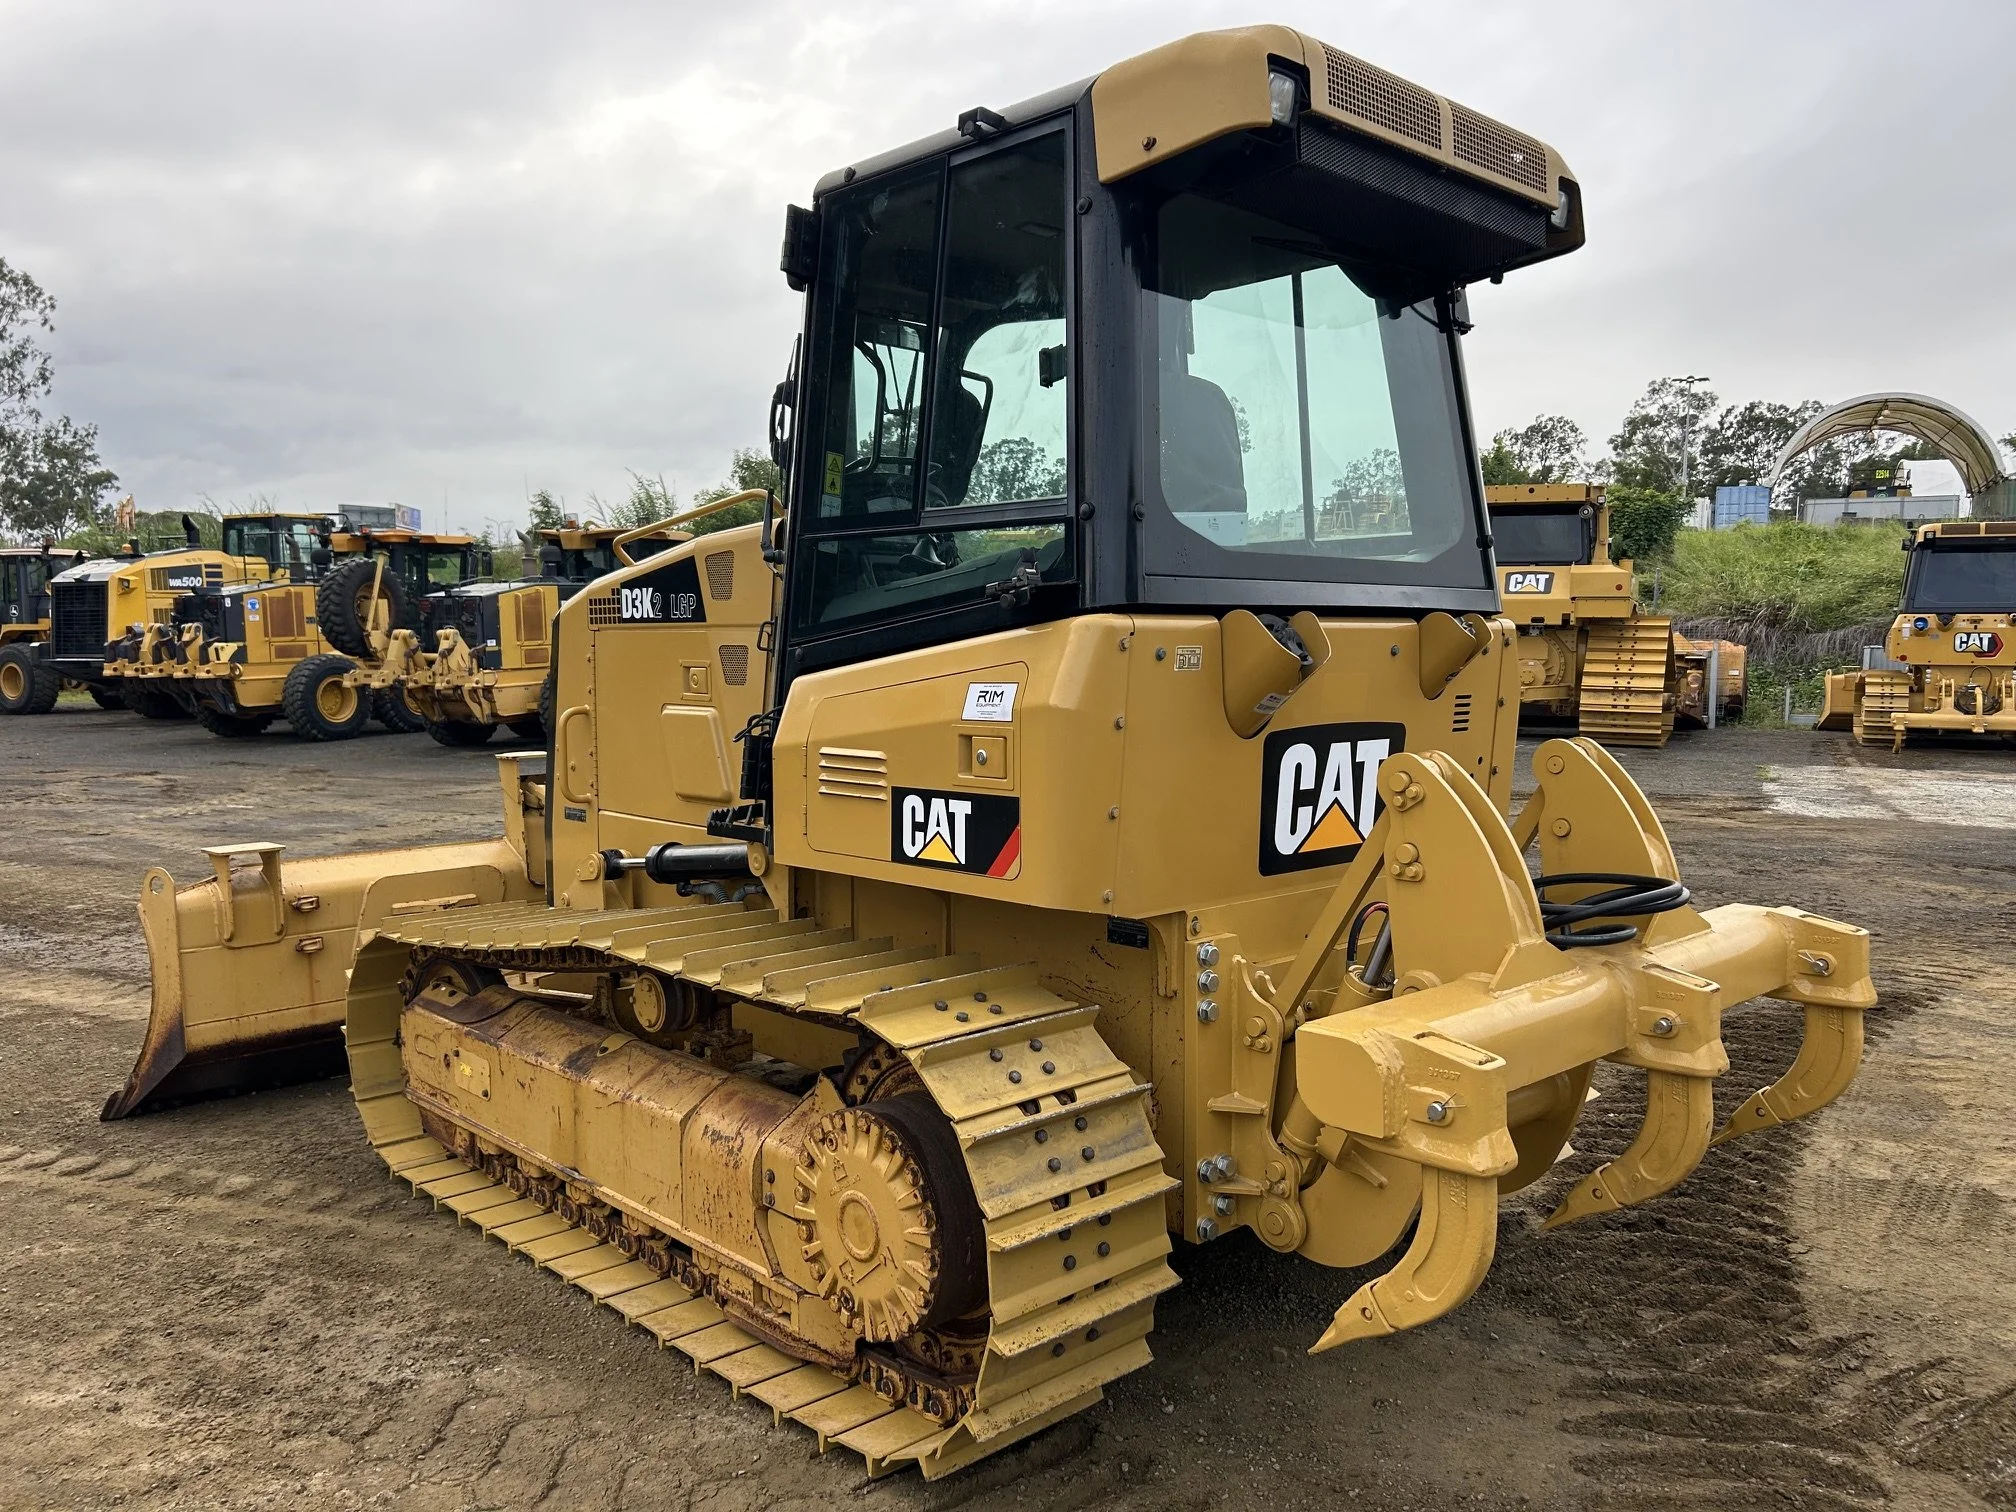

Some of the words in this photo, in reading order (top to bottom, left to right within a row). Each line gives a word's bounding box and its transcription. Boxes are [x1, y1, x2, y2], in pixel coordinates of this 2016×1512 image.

[168, 576, 203, 588] WA500
[1508, 573, 1550, 592] CAT
[670, 593, 697, 618] LGP
[1954, 632, 1993, 652] CAT
[976, 690, 1005, 703] RIM
[1274, 738, 1390, 855] CAT
[902, 794, 972, 865] CAT
